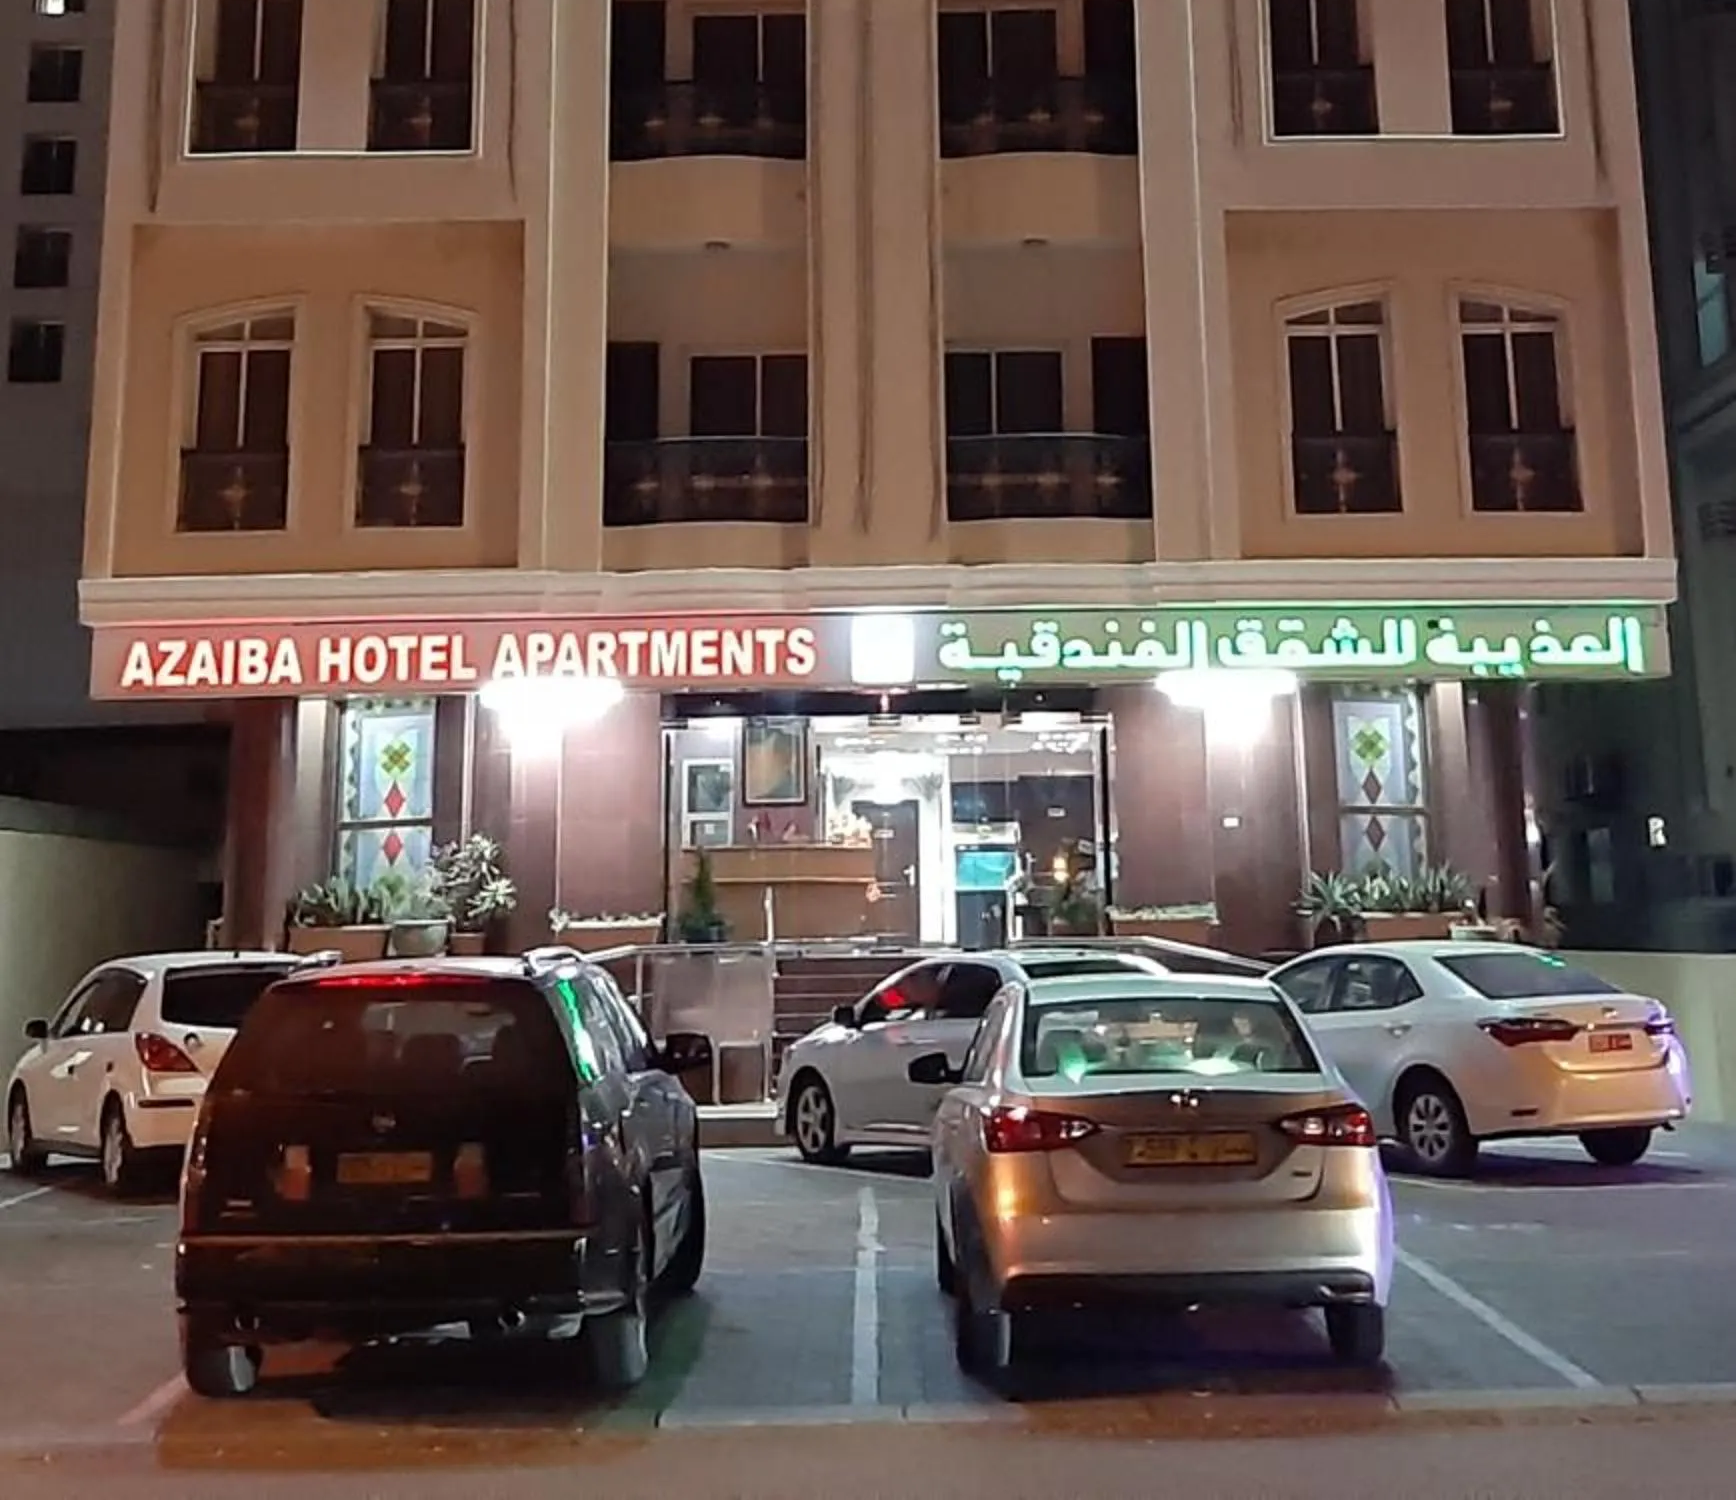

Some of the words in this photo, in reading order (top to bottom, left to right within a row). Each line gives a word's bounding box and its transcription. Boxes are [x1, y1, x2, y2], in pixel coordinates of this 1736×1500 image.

[120, 637, 303, 688] AZAIBA
[317, 633, 478, 684] HOTEL
[491, 626, 817, 678] APARTMENTS
[938, 618, 1209, 682] الفندقية
[1217, 616, 1417, 668] للشقق
[1424, 615, 1646, 677] العذيبة
